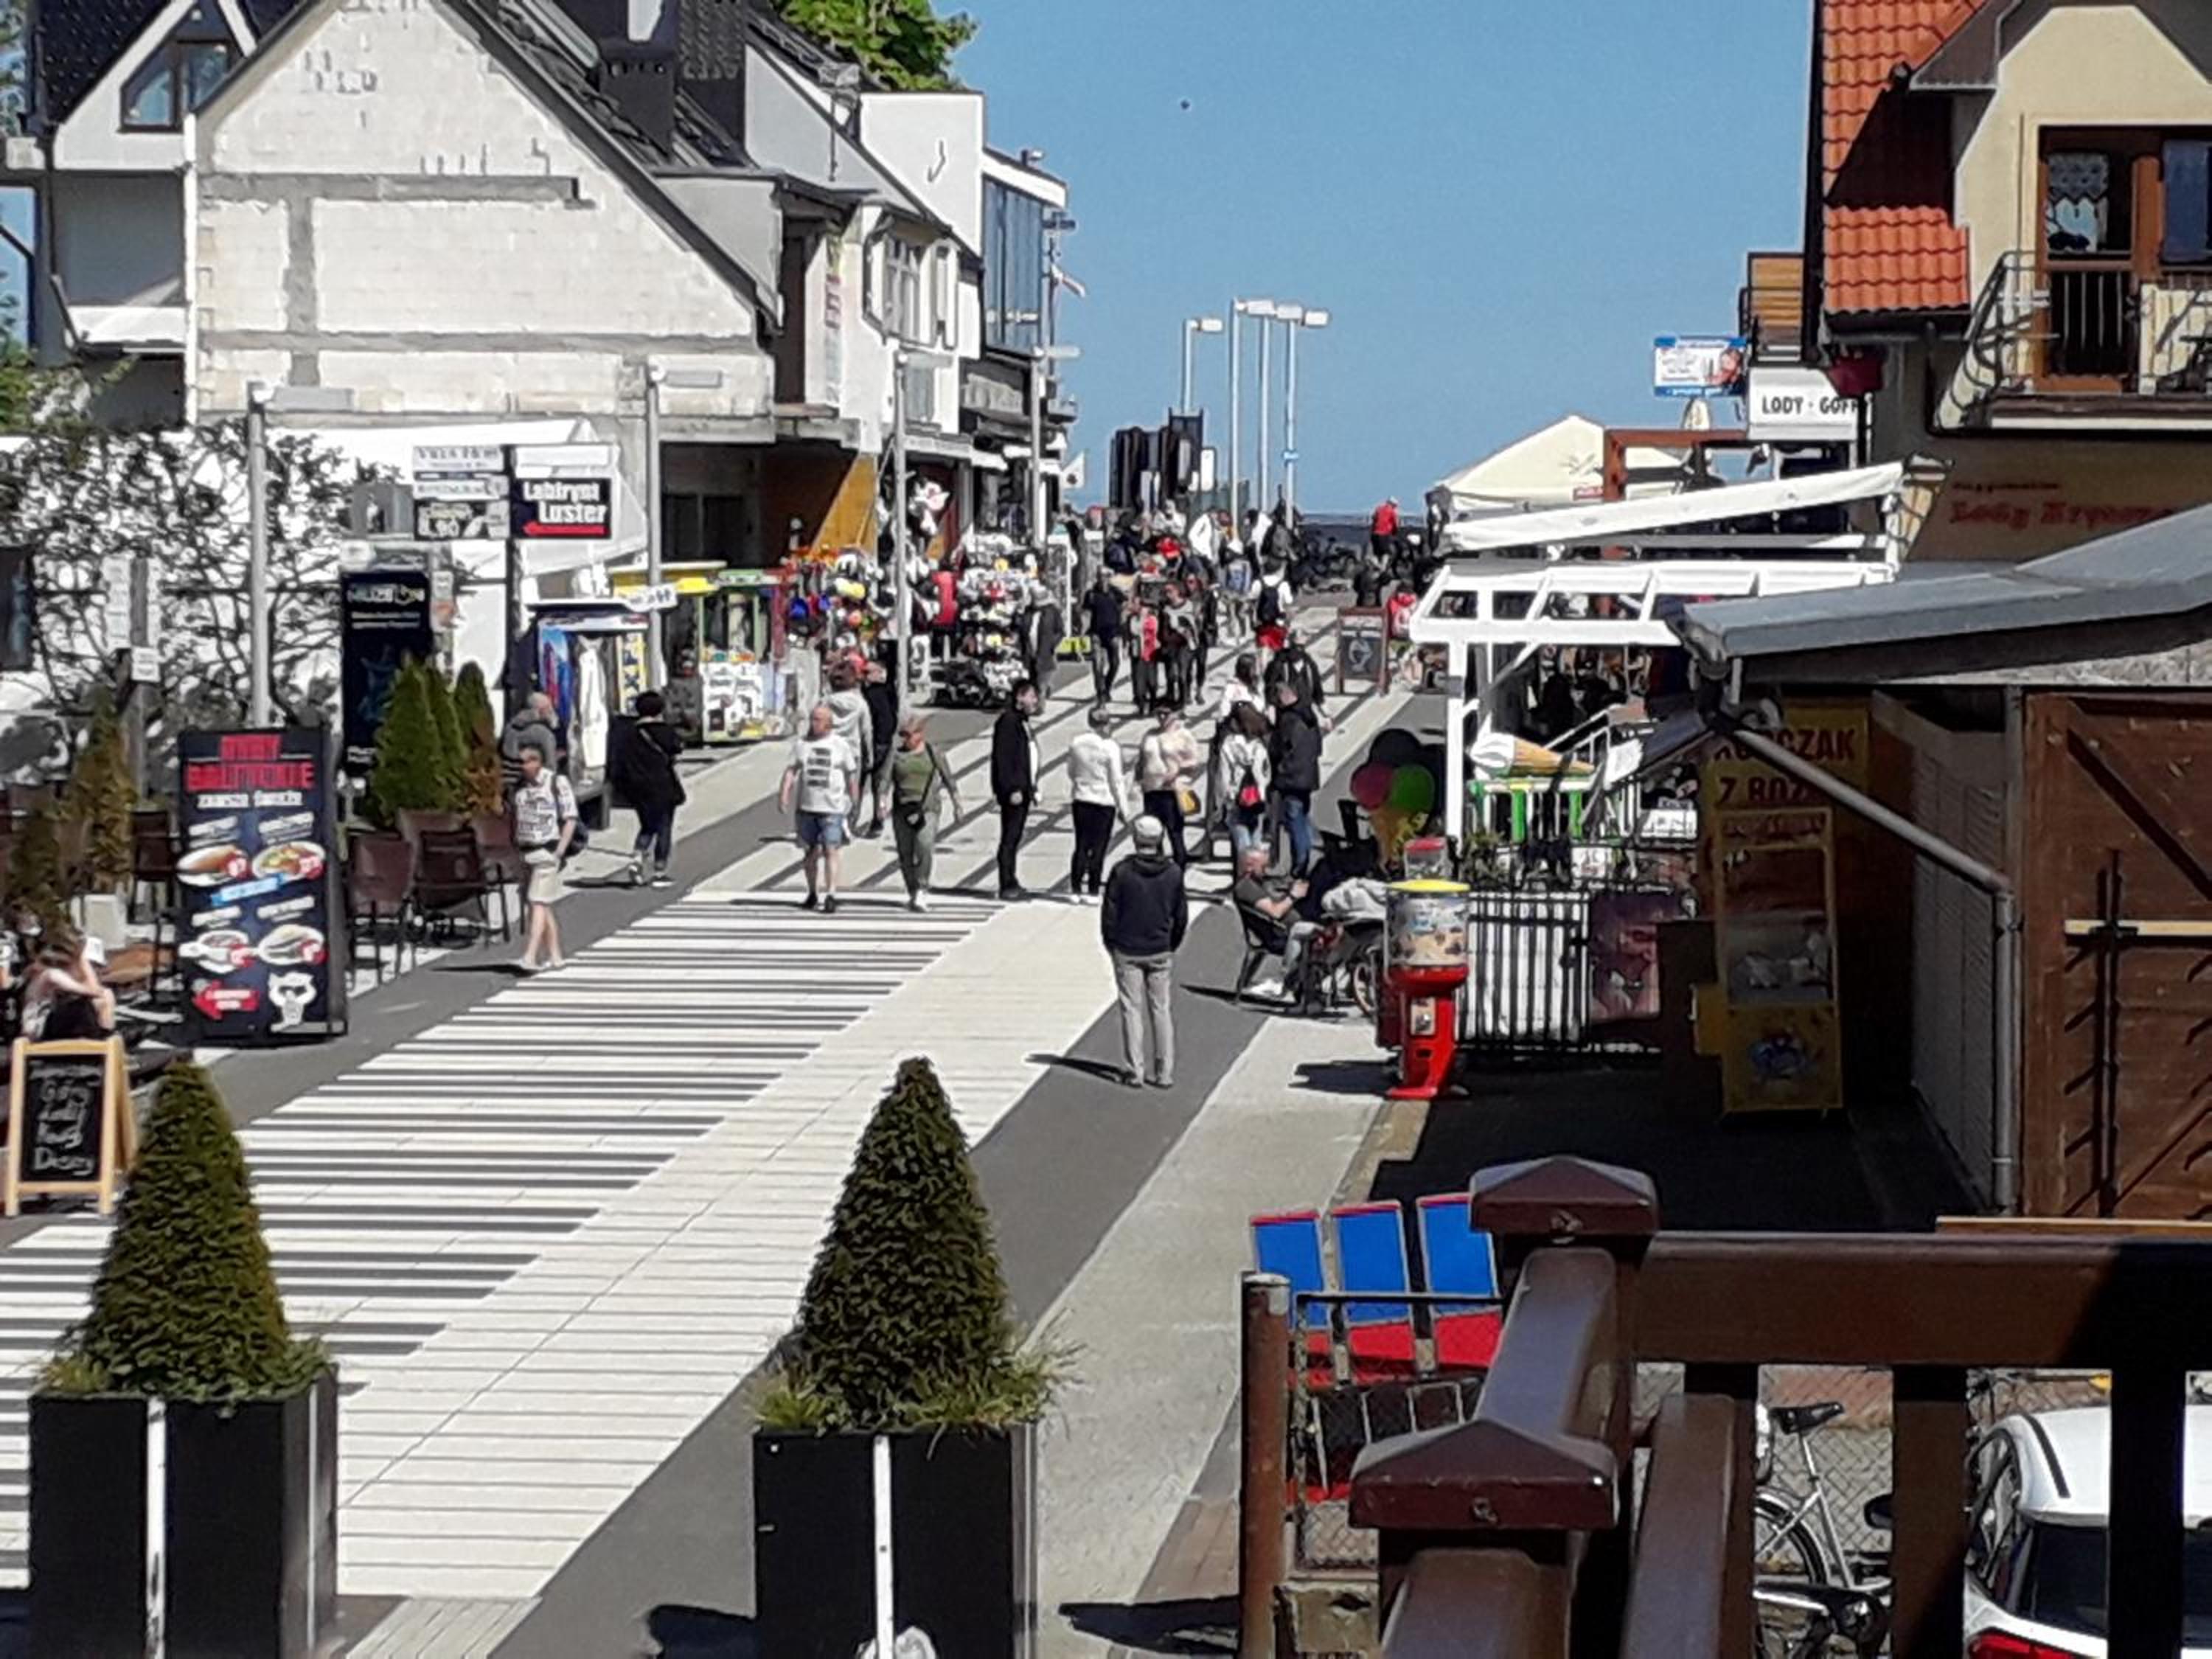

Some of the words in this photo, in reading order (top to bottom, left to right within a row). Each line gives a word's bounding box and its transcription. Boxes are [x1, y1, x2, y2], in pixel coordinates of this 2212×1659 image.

[1761, 396, 1804, 414] LODY
[523, 481, 600, 504] Labirynt
[538, 501, 608, 524] Luster
